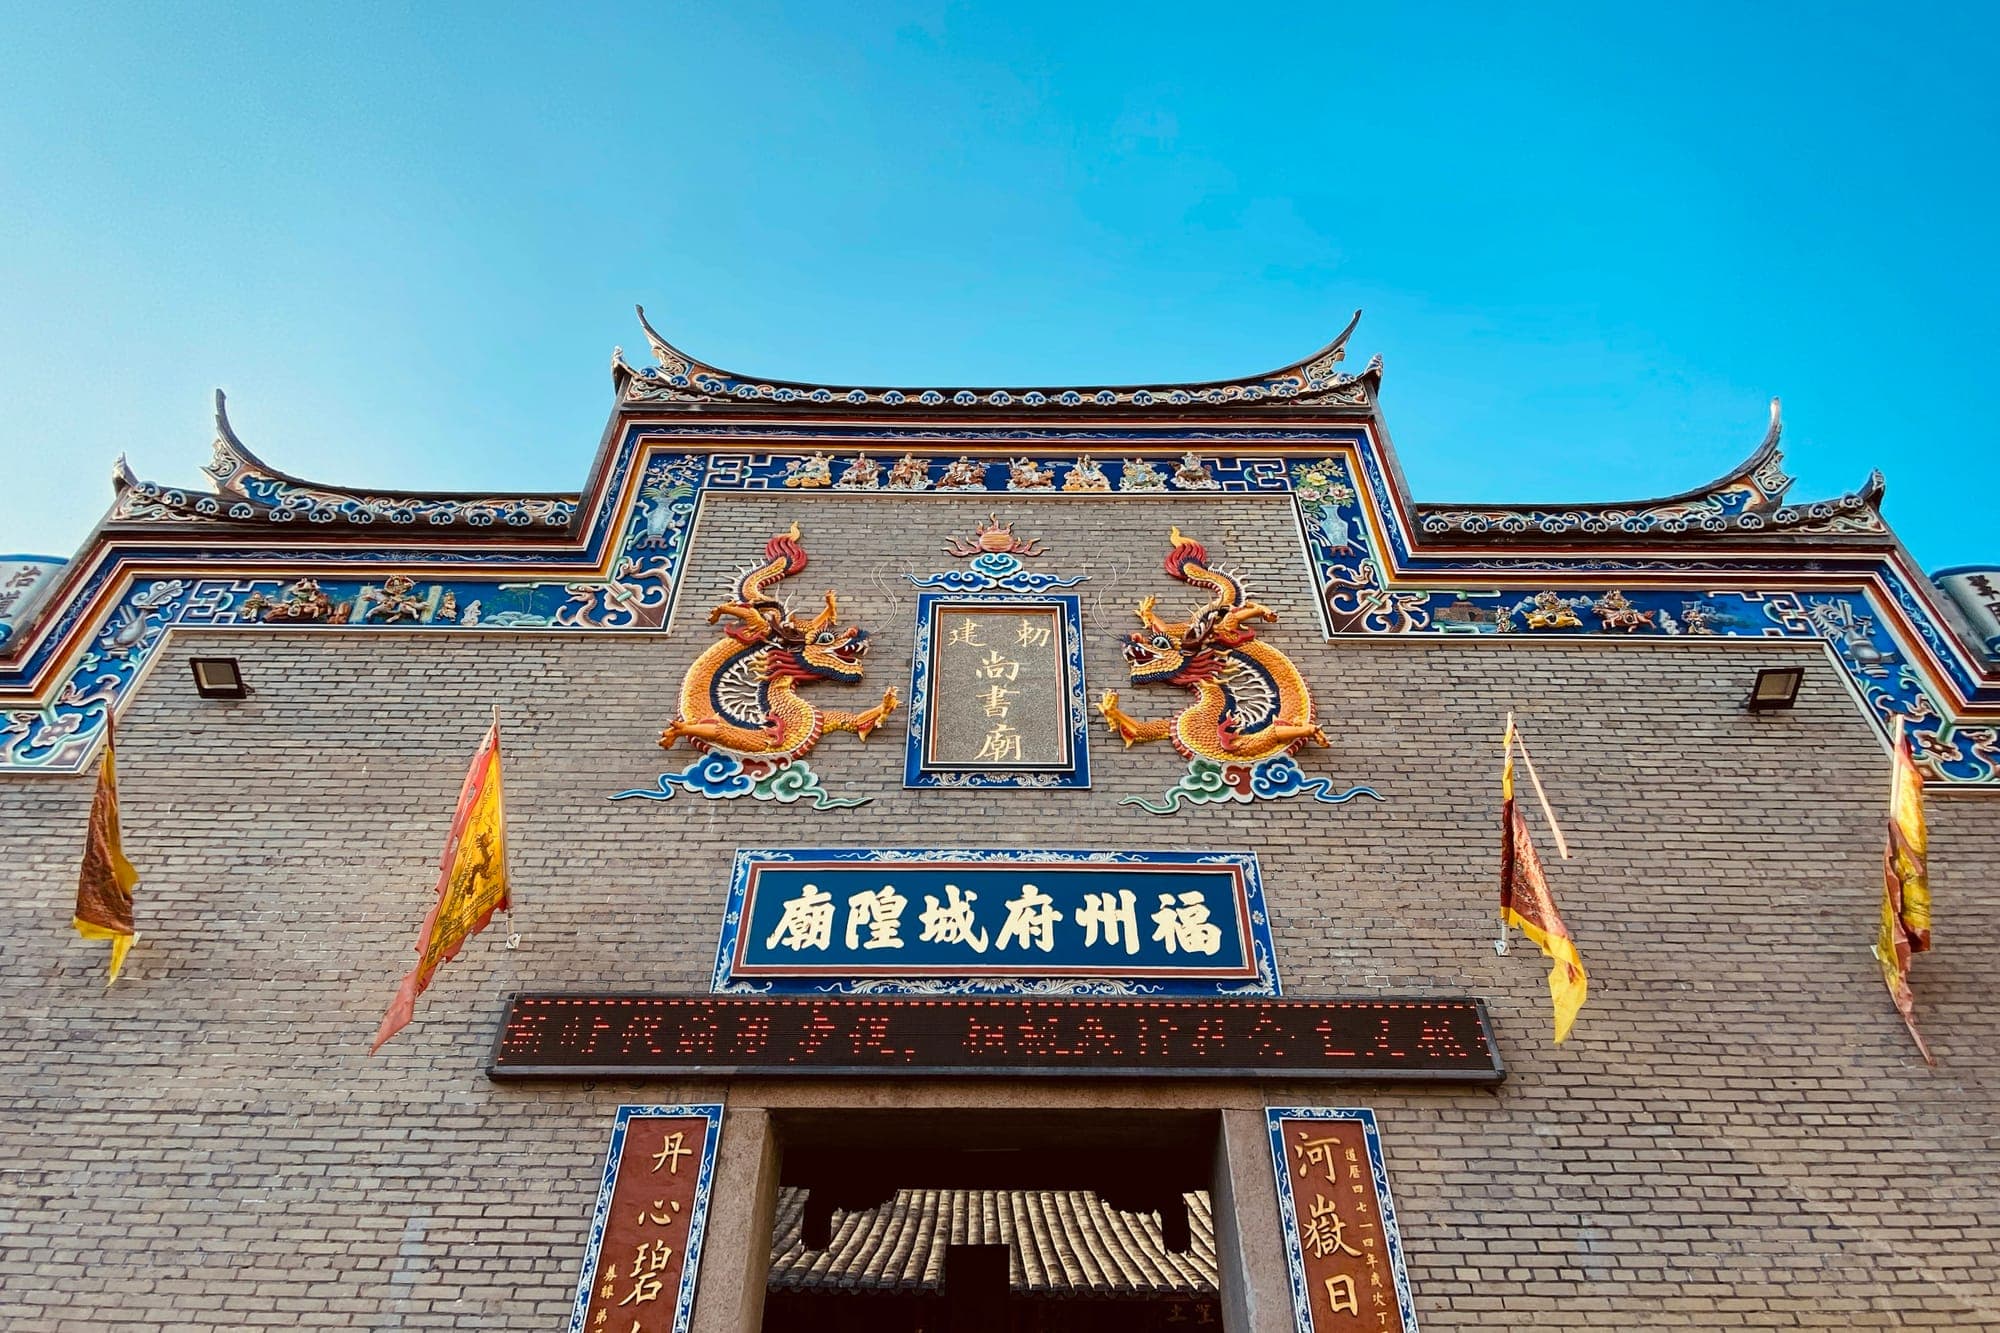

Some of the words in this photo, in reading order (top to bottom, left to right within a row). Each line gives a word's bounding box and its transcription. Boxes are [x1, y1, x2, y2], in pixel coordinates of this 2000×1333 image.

[973, 650, 1022, 762] 尚書廟
[766, 884, 1222, 956] 福州府城隍廟
[618, 1131, 693, 1333] 丹心碧
[1344, 1147, 1389, 1333] 道曆四七一四年歲次丁
